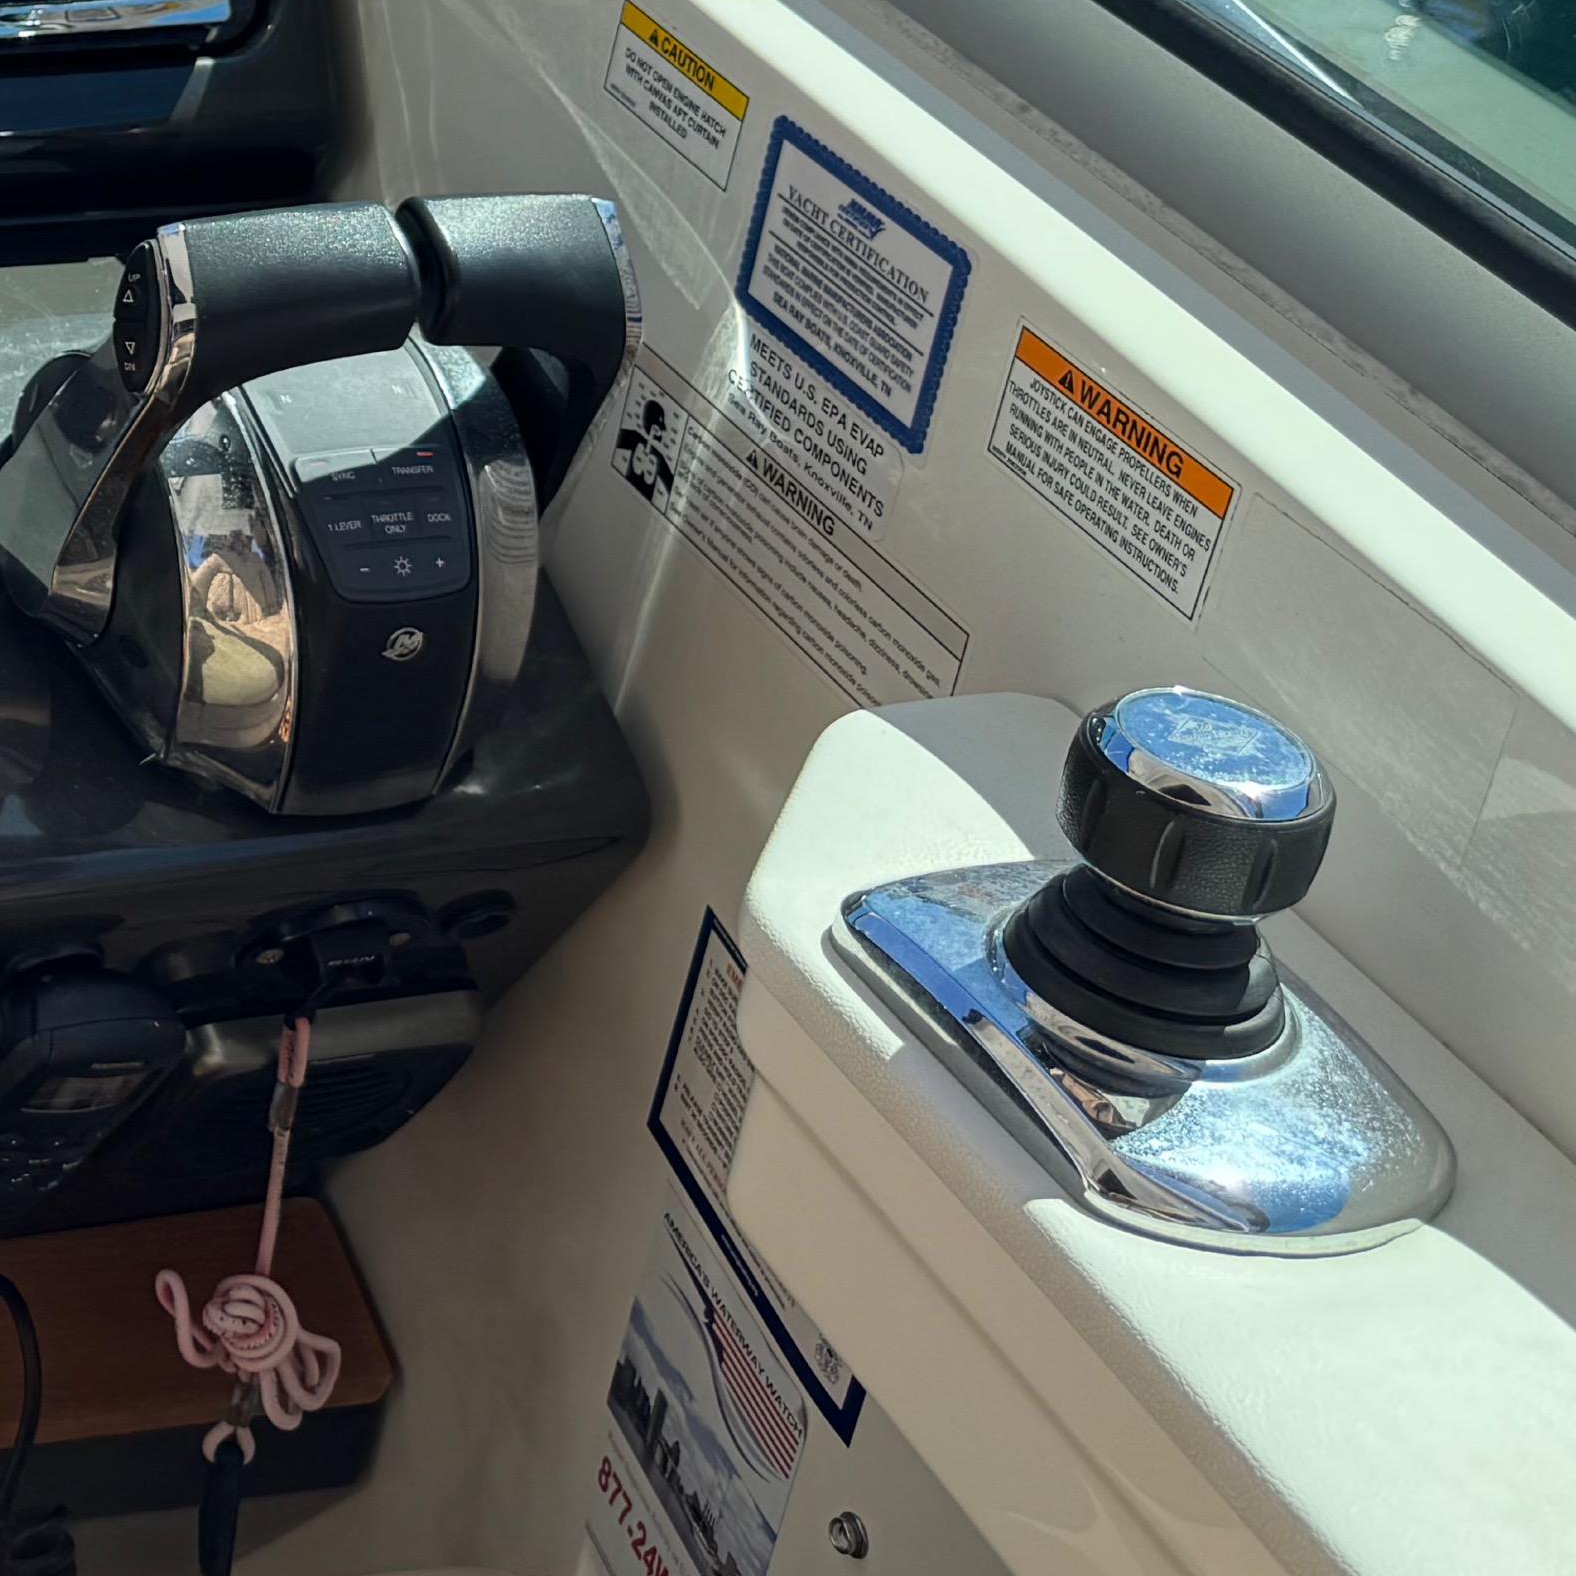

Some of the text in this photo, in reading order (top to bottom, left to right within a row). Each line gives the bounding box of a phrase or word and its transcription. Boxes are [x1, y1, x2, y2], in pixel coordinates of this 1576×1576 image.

[625, 47, 727, 138] DO NOT OPEN ENGINE HATCH
[625, 64, 644, 86] WITH
[643, 77, 674, 109] CANVAS
[672, 102, 688, 122] AFT
[687, 112, 721, 151] CURTAIN
[660, 36, 716, 91] CAUTION
[648, 100, 688, 140] INSTALLED
[789, 184, 830, 225] YACHT
[828, 219, 929, 304] CERTIFICATION
[749, 361, 868, 476] STANDARDS USING
[750, 333, 885, 458] MEETS U.S. EPA EVAP
[1080, 379, 1184, 479] WARNING
[332, 471, 355, 481] SYNC
[391, 465, 434, 476] TRANSFER
[793, 428, 885, 519] COMPONENTS
[1009, 379, 1212, 552] THROTTLES ARE IN NEUTRAL. NEVER LEAVE ENGINES
[1009, 403, 1196, 562] RUNNING WITH PEOPLE IN THE WATER. DEATH OR
[1030, 378, 1198, 518] JOYSTICK CAN ENGAGE PROPELLERS WHEN
[334, 519, 362, 531] LEVER
[371, 512, 415, 523] THROTTLE
[385, 524, 407, 535] ONLY
[427, 512, 452, 523] DOCK
[763, 453, 836, 537] WARNING
[858, 509, 874, 531] TN
[1006, 440, 1036, 475] MANUAL
[1037, 467, 1054, 489] FOR
[1053, 480, 1075, 508] SAFE
[1074, 495, 1120, 543] OPERATING
[1119, 535, 1179, 594] INSTRUCTIONS.
[1009, 423, 1043, 458] SERIOUS
[1042, 449, 1070, 480] INJURY
[1069, 473, 1097, 503] COULD
[1097, 495, 1128, 530] RESULT.
[1131, 524, 1150, 546] SEE
[1149, 538, 1188, 577] OWNER'S
[663, 1212, 710, 1288] AMERICA'S
[711, 1285, 766, 1375] WATERWAY
[766, 1375, 804, 1439] WATCH
